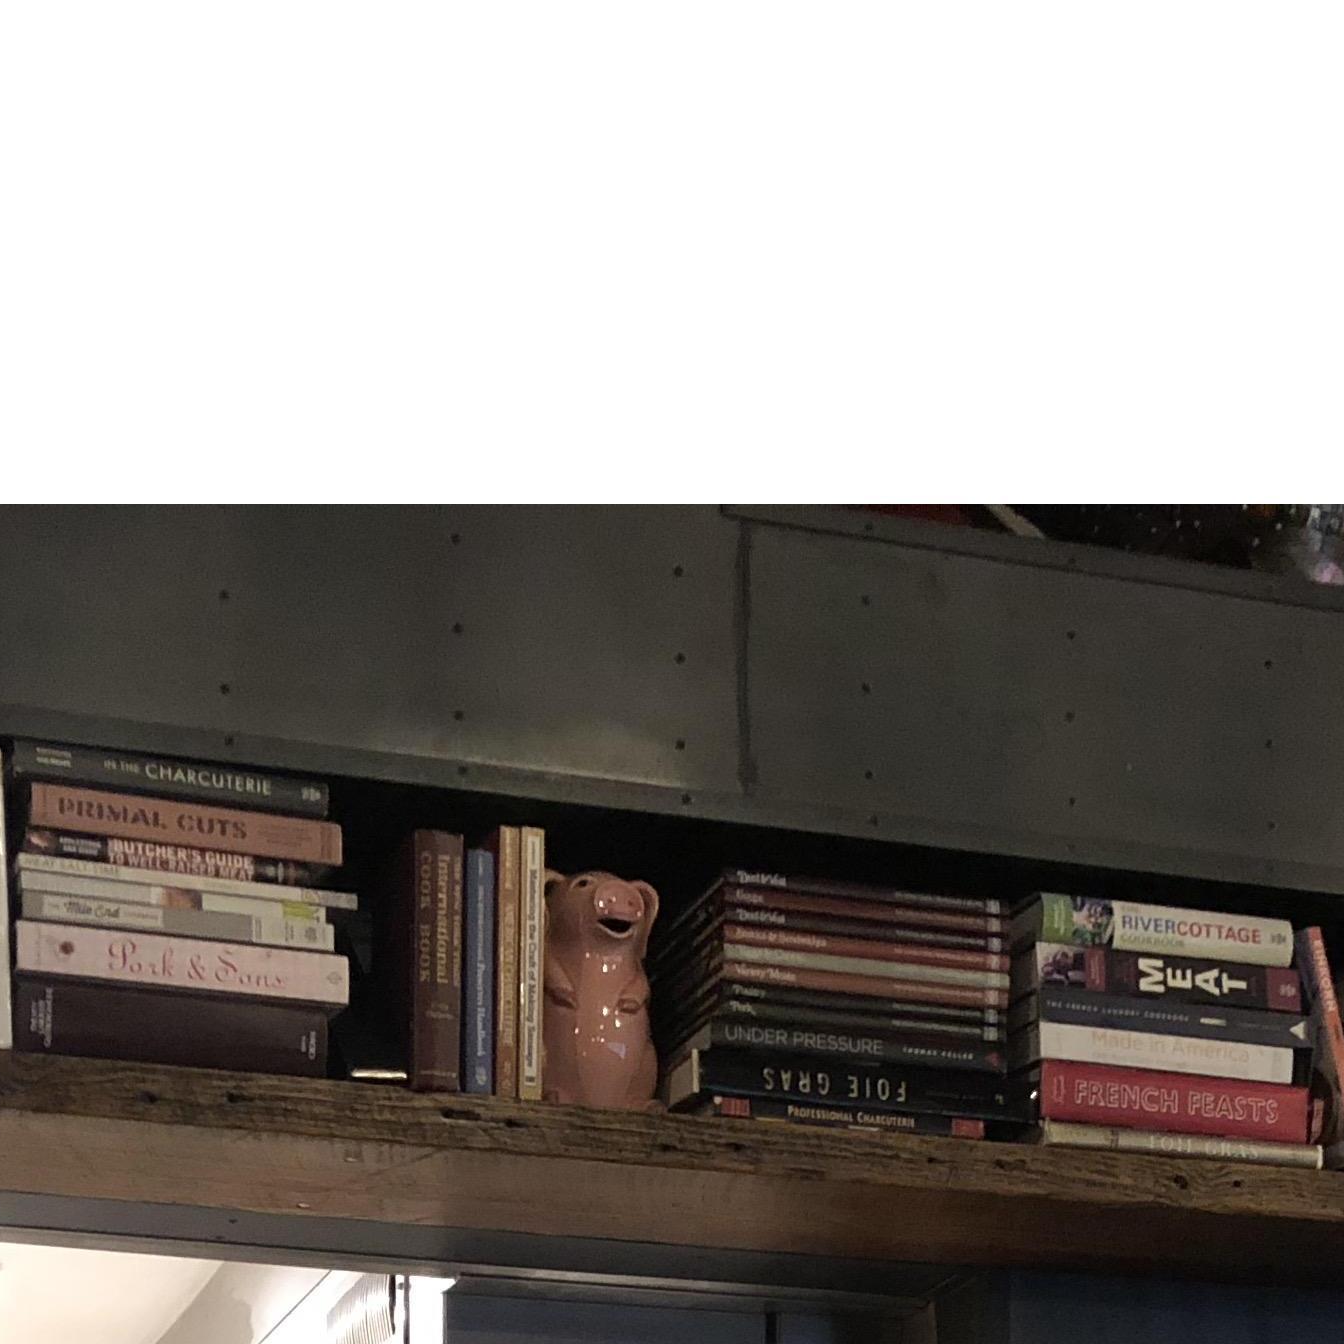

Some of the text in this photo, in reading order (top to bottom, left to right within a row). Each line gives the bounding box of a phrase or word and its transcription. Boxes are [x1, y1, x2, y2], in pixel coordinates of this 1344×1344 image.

[145, 763, 271, 796] CHARCUTERIE
[58, 798, 247, 840] PRIMAL CUTS
[113, 838, 201, 861] BUTCHER'S
[206, 850, 253, 870] GUIDE
[419, 852, 432, 982] COOK BOOK
[437, 854, 450, 984] International
[107, 940, 173, 977] Pork
[187, 954, 205, 982] &
[1137, 957, 1248, 997] MEAT
[725, 1025, 788, 1044] UNDER
[793, 1032, 883, 1055] PRESSURE
[761, 1067, 907, 1102] FOIE GRAS
[1074, 1080, 1279, 1124] FRENCH FEASTS
